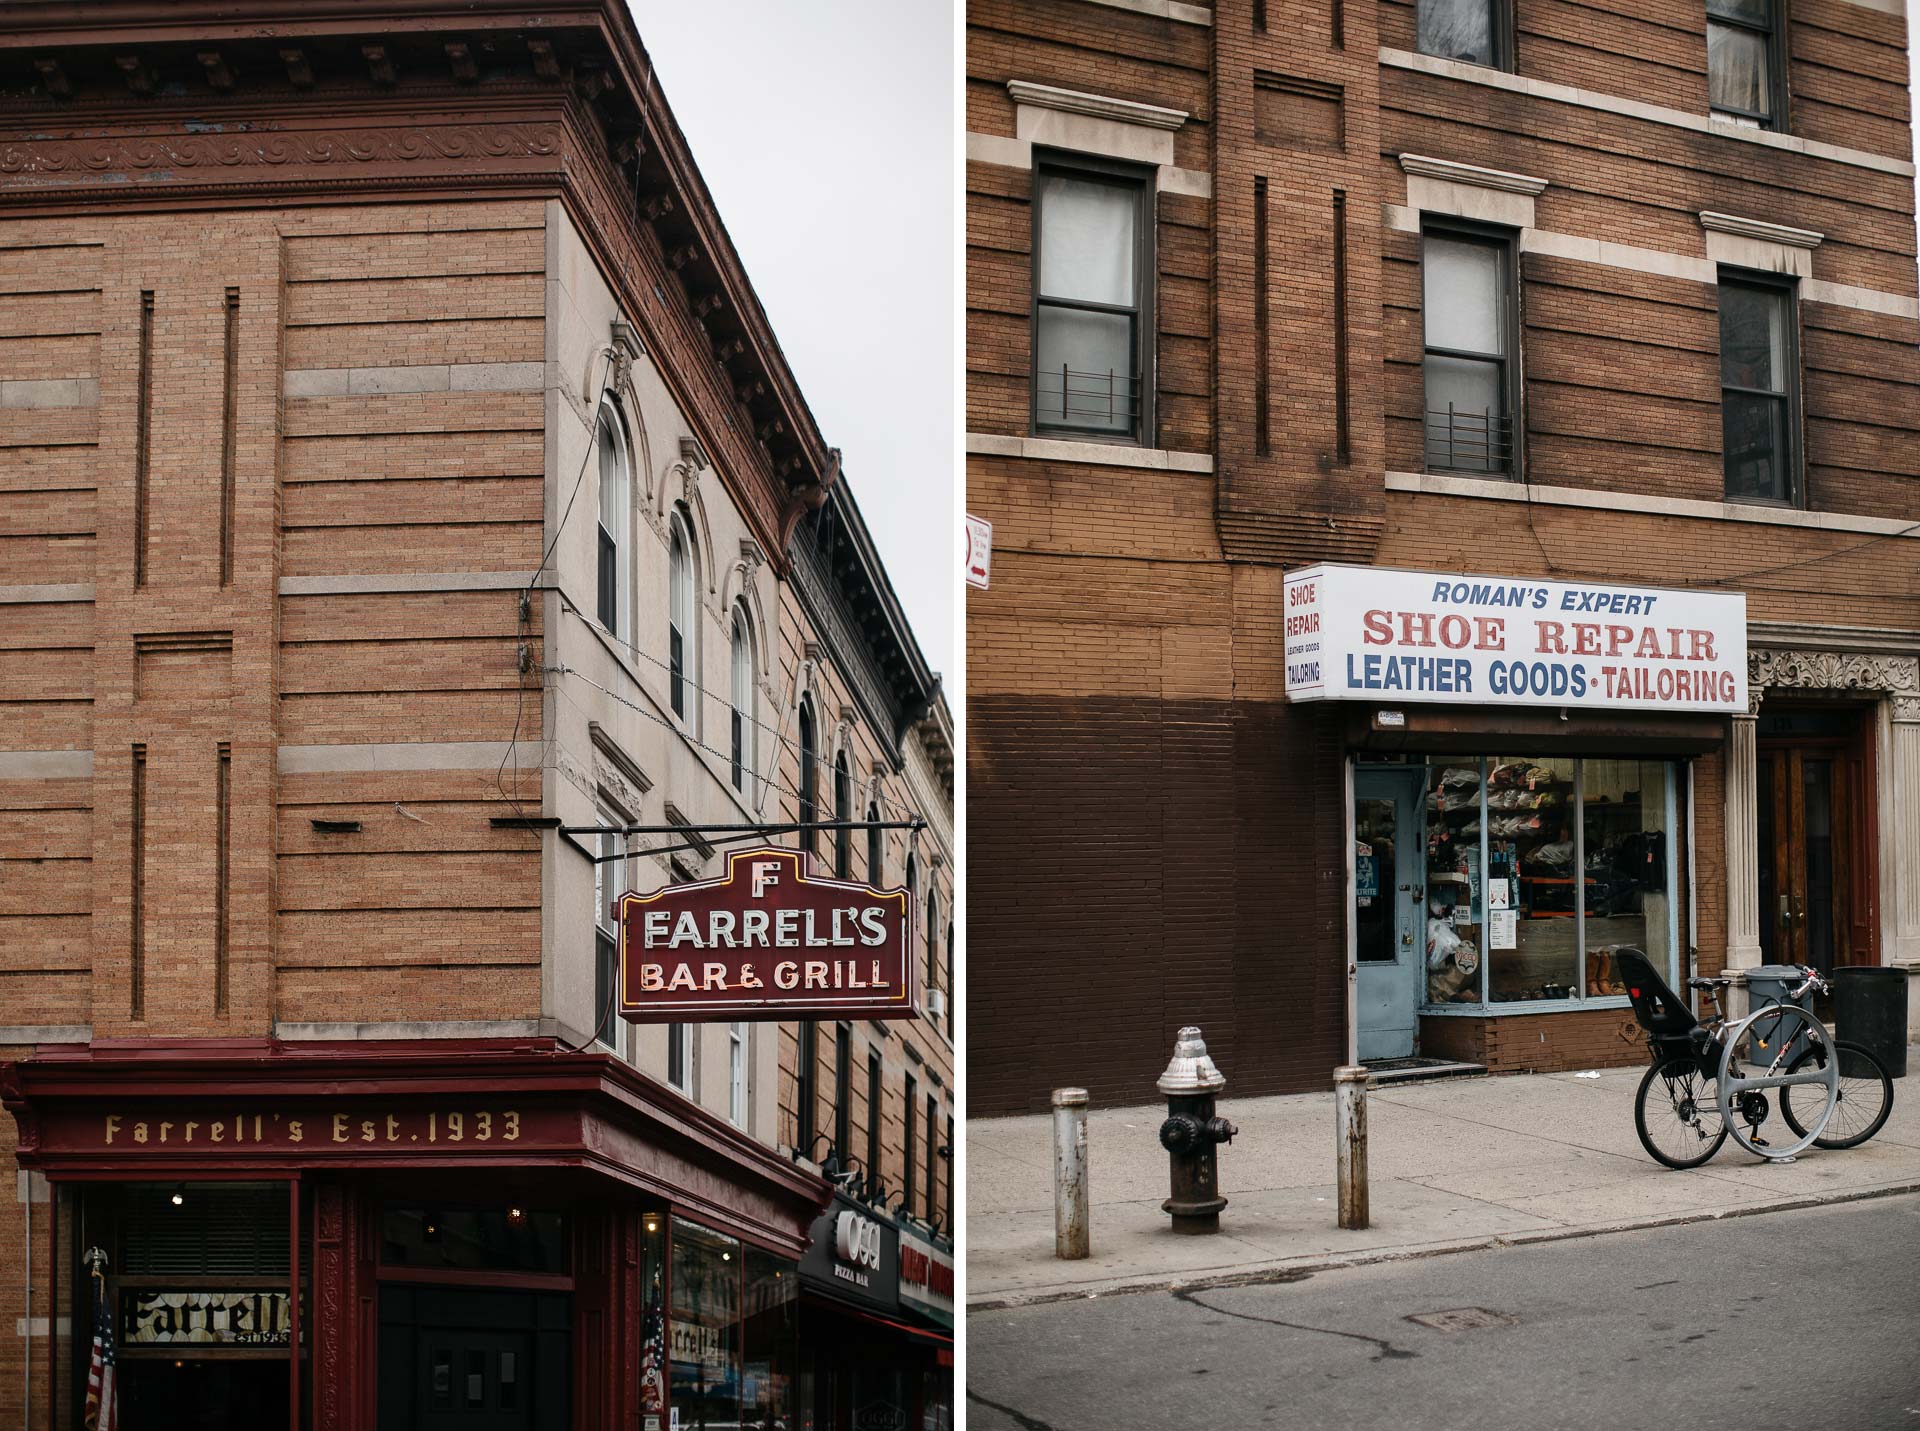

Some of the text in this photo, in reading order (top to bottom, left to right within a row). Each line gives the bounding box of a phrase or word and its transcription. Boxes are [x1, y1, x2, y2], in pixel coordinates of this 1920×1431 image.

[1290, 584, 1315, 607] SHOE
[1432, 581, 1657, 616] ROMAN'S EXPERT
[1287, 613, 1320, 637] REPAIR
[1363, 609, 1718, 662] SHOE REPAIR
[1288, 643, 1320, 655] LEATHER GOODS
[1288, 662, 1320, 685] TAILORING
[1347, 653, 1735, 702] LEATHER GOODS TAILORING
[752, 862, 781, 897] F
[644, 907, 887, 949] FARRELL'S
[640, 960, 890, 992] BAR & GRILL
[105, 1113, 303, 1145] Farrell's
[834, 1264, 869, 1288] PIZZA BAR
